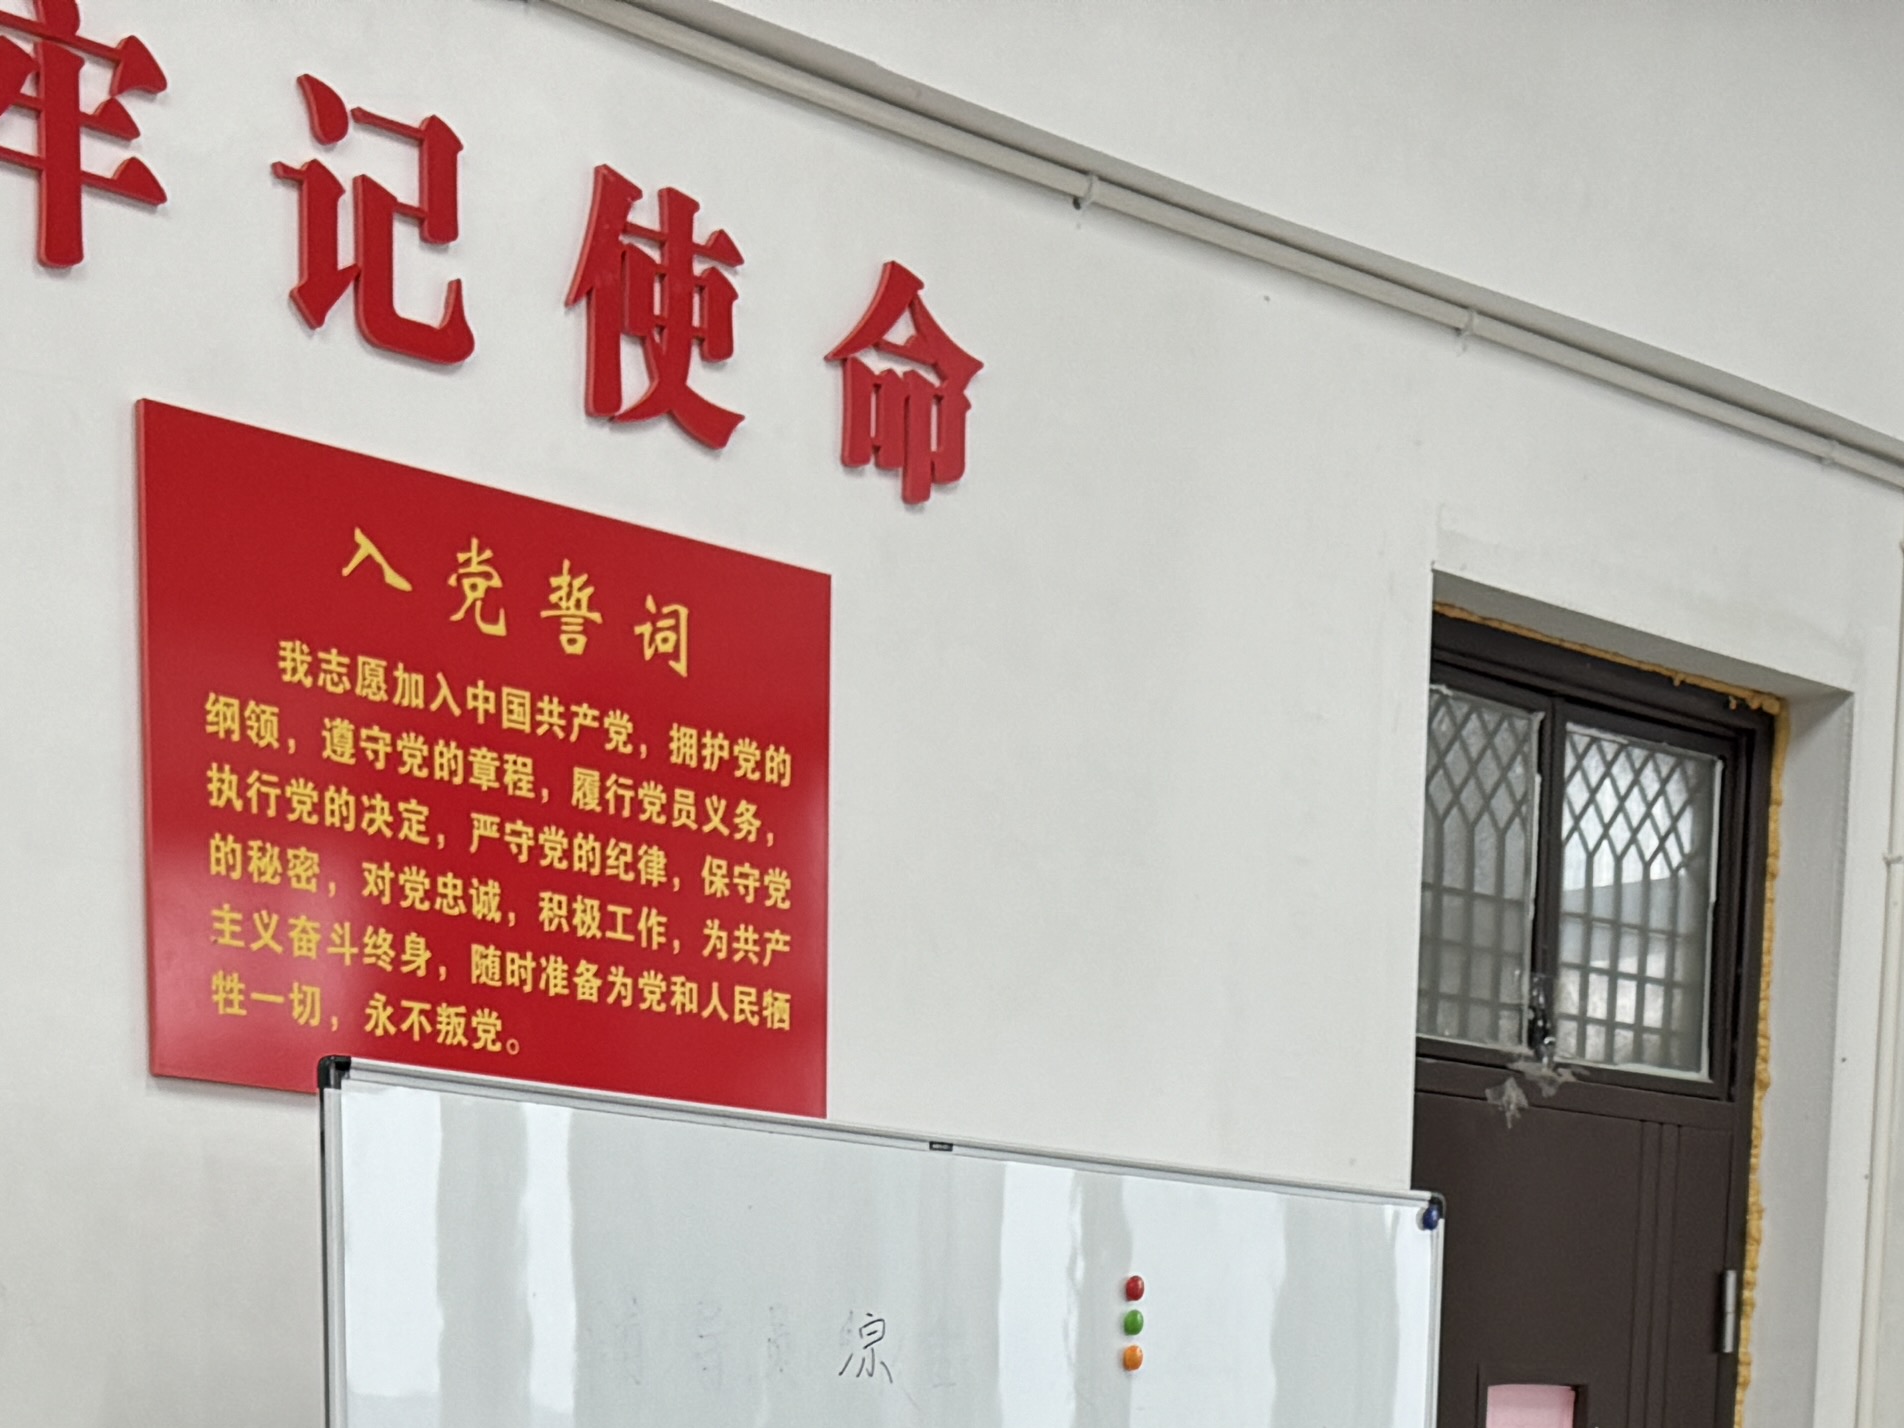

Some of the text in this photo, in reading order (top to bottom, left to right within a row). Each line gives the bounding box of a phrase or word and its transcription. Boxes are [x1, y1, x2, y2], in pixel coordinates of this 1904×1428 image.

[341, 526, 690, 678] 入党誓词
[204, 692, 776, 848] 纲领，遵守党的章程，履行党员义务，
[277, 639, 793, 787] 我志愿加入中国共产党，拥护党的
[205, 762, 792, 909] 执行党的决定，严守党的纪律，保守党
[209, 834, 792, 967] 的秘密，对党忠诚，积极工作，为共产
[211, 904, 792, 1030] 主义奋斗终身，随时准备为党和人民牺
[211, 970, 522, 1056] 牲一切，永不叛党。
